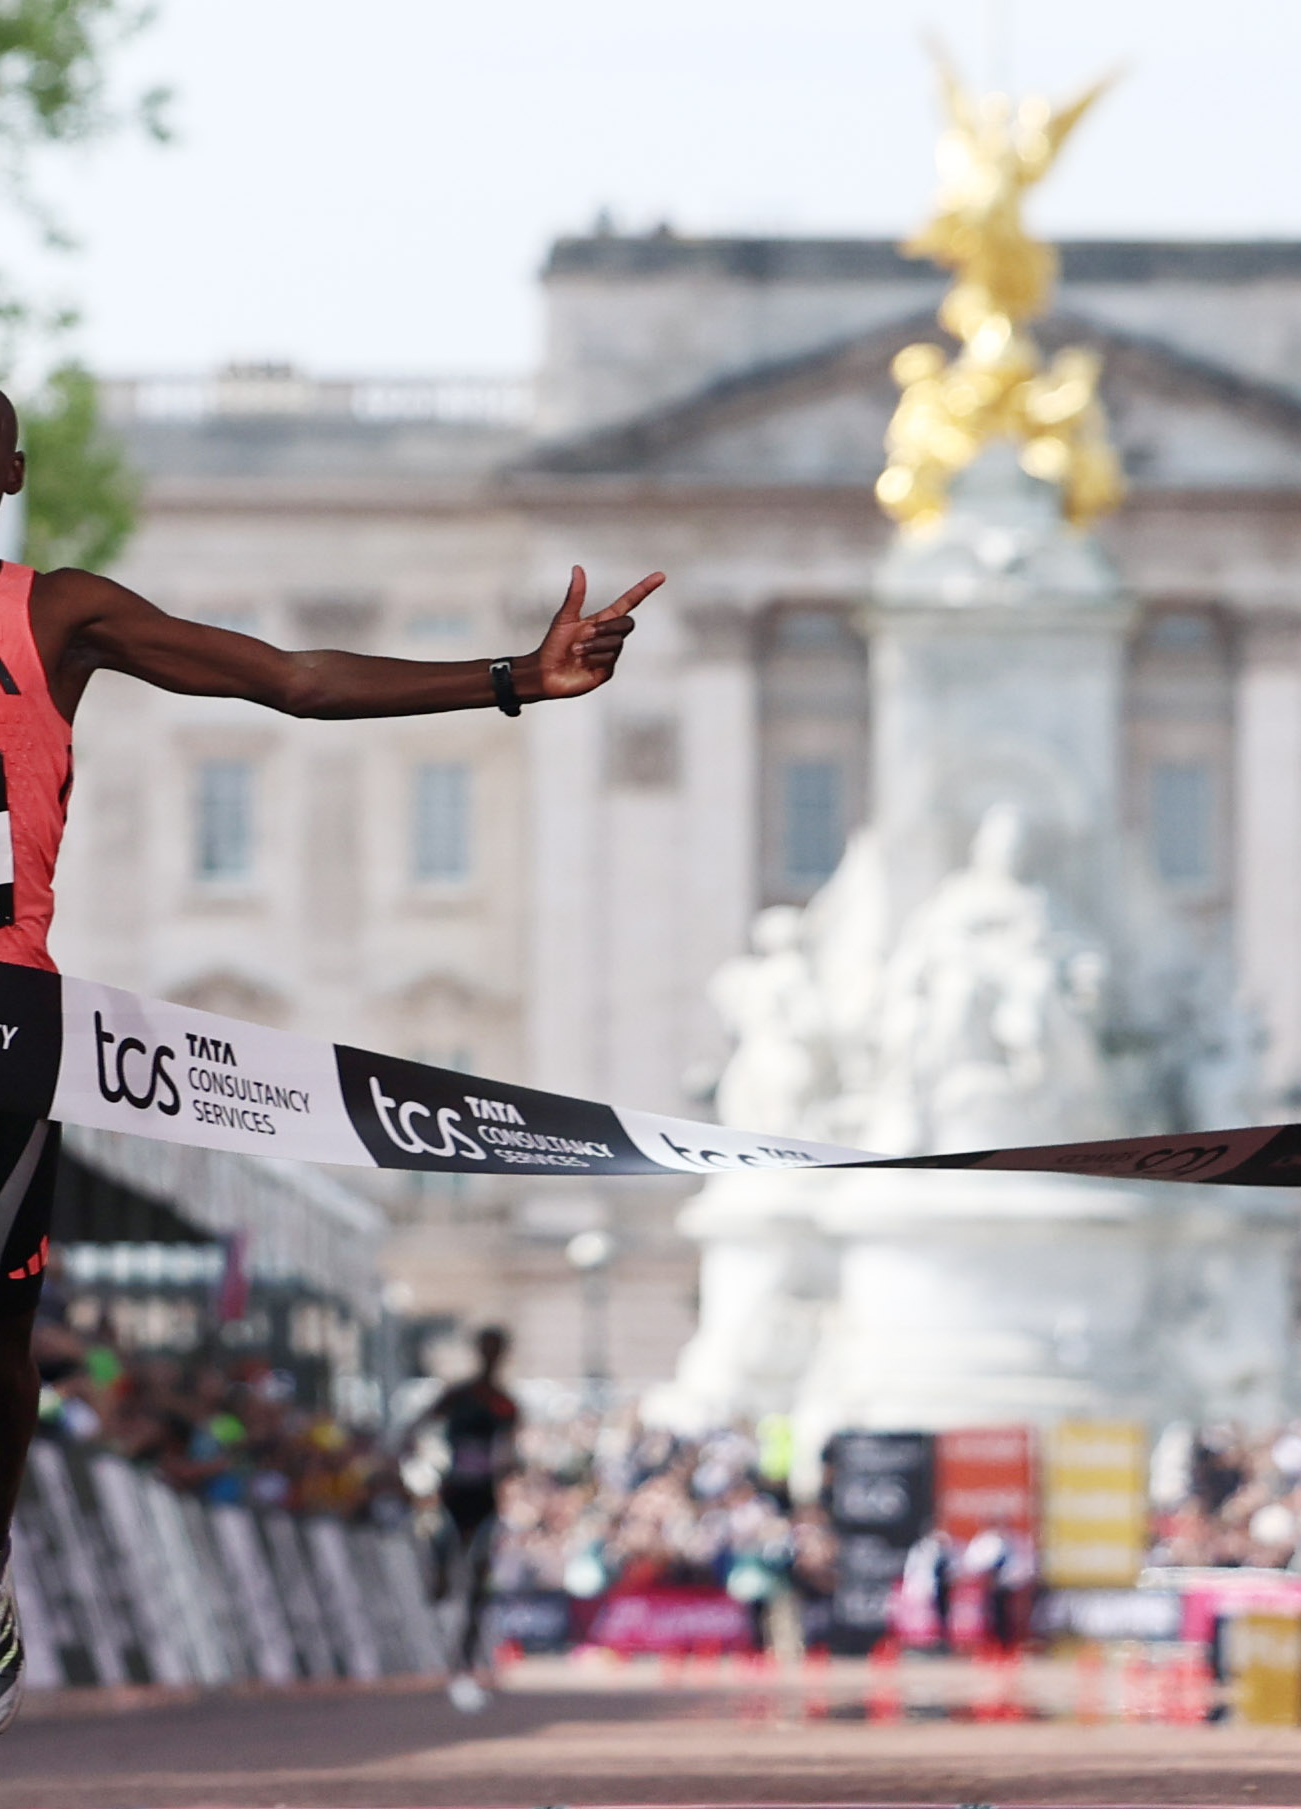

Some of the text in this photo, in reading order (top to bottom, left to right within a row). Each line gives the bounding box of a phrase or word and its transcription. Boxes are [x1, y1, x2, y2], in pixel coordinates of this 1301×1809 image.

[94, 1010, 181, 1116] tcs
[185, 1033, 237, 1067] TATA
[188, 1067, 310, 1114] CONSULTANCY
[193, 1099, 276, 1135] SERVICES
[369, 1076, 487, 1160] tcs
[463, 1095, 526, 1125] TATA
[477, 1125, 615, 1158] CONSULTANCY
[494, 1149, 590, 1167] SERVICES
